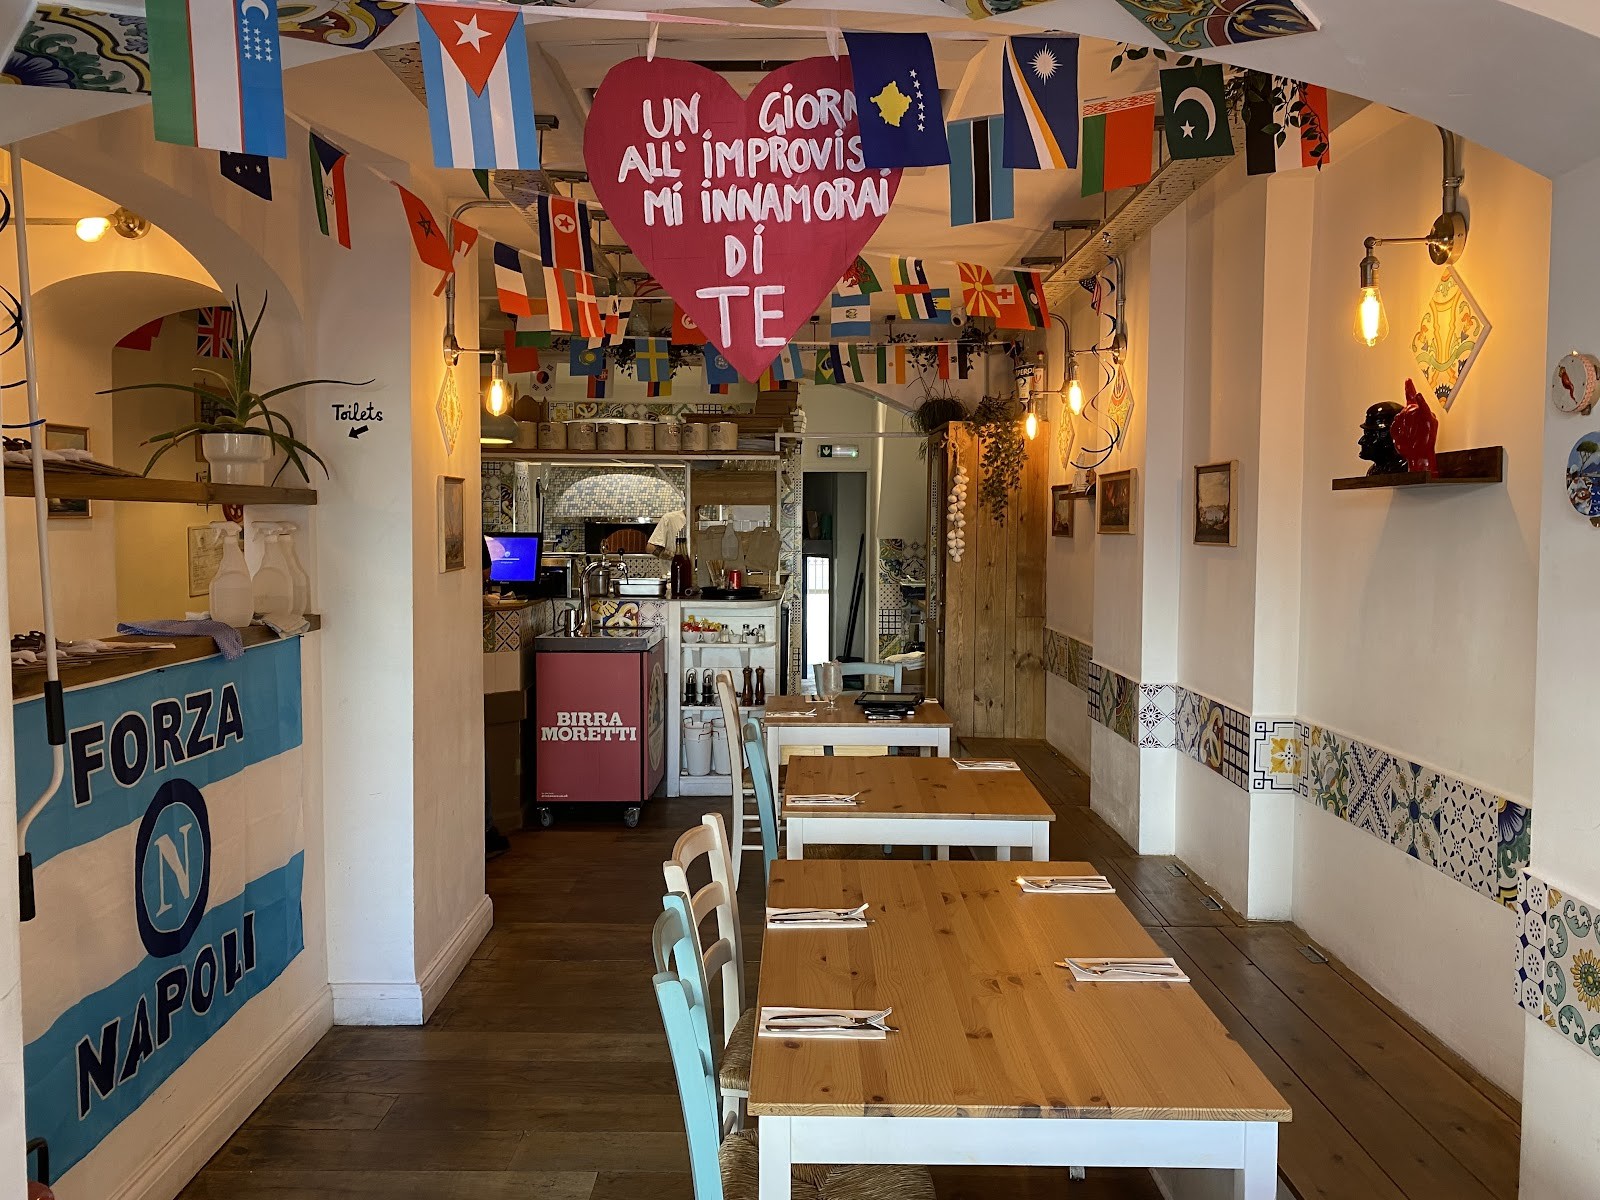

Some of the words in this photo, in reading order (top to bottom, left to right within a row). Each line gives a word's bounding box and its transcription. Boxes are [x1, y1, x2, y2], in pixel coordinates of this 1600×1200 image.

[643, 92, 700, 138] UN
[702, 129, 865, 178] IMPROVIS
[696, 285, 787, 348] TE
[332, 402, 383, 421] Toilets
[541, 726, 636, 741] MORETTI
[556, 711, 623, 726] BIRRA
[69, 682, 243, 808] FORZA
[154, 823, 191, 917] N
[75, 910, 255, 1121] NAPOLI
